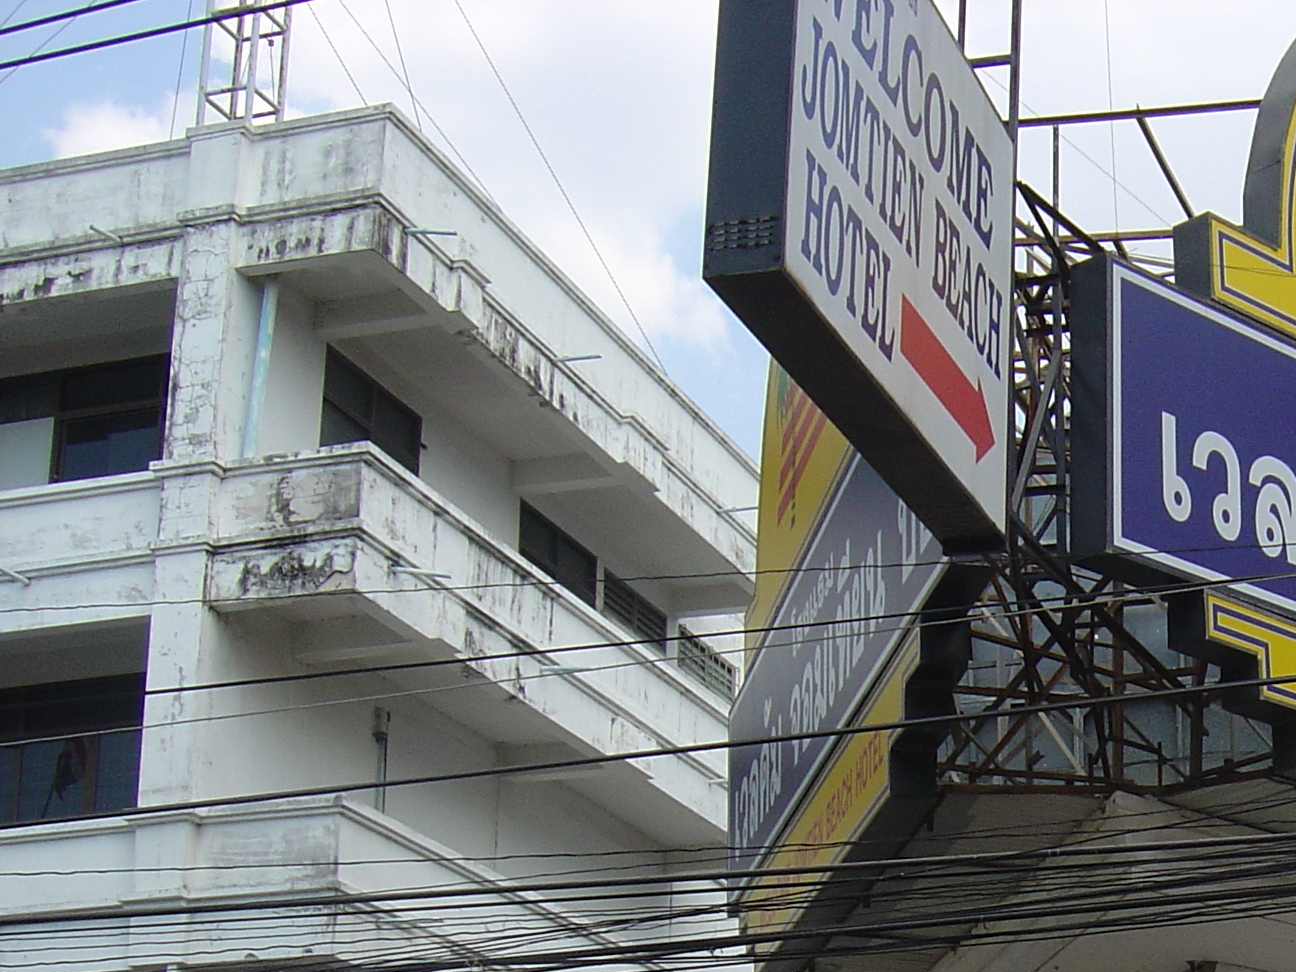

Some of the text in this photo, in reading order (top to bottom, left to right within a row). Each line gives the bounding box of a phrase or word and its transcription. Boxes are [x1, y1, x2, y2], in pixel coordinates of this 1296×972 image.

[801, 15, 1003, 380] JOMTIEN BEACH
[825, 0, 993, 251] ELCOME
[801, 148, 895, 363] HOTEL
